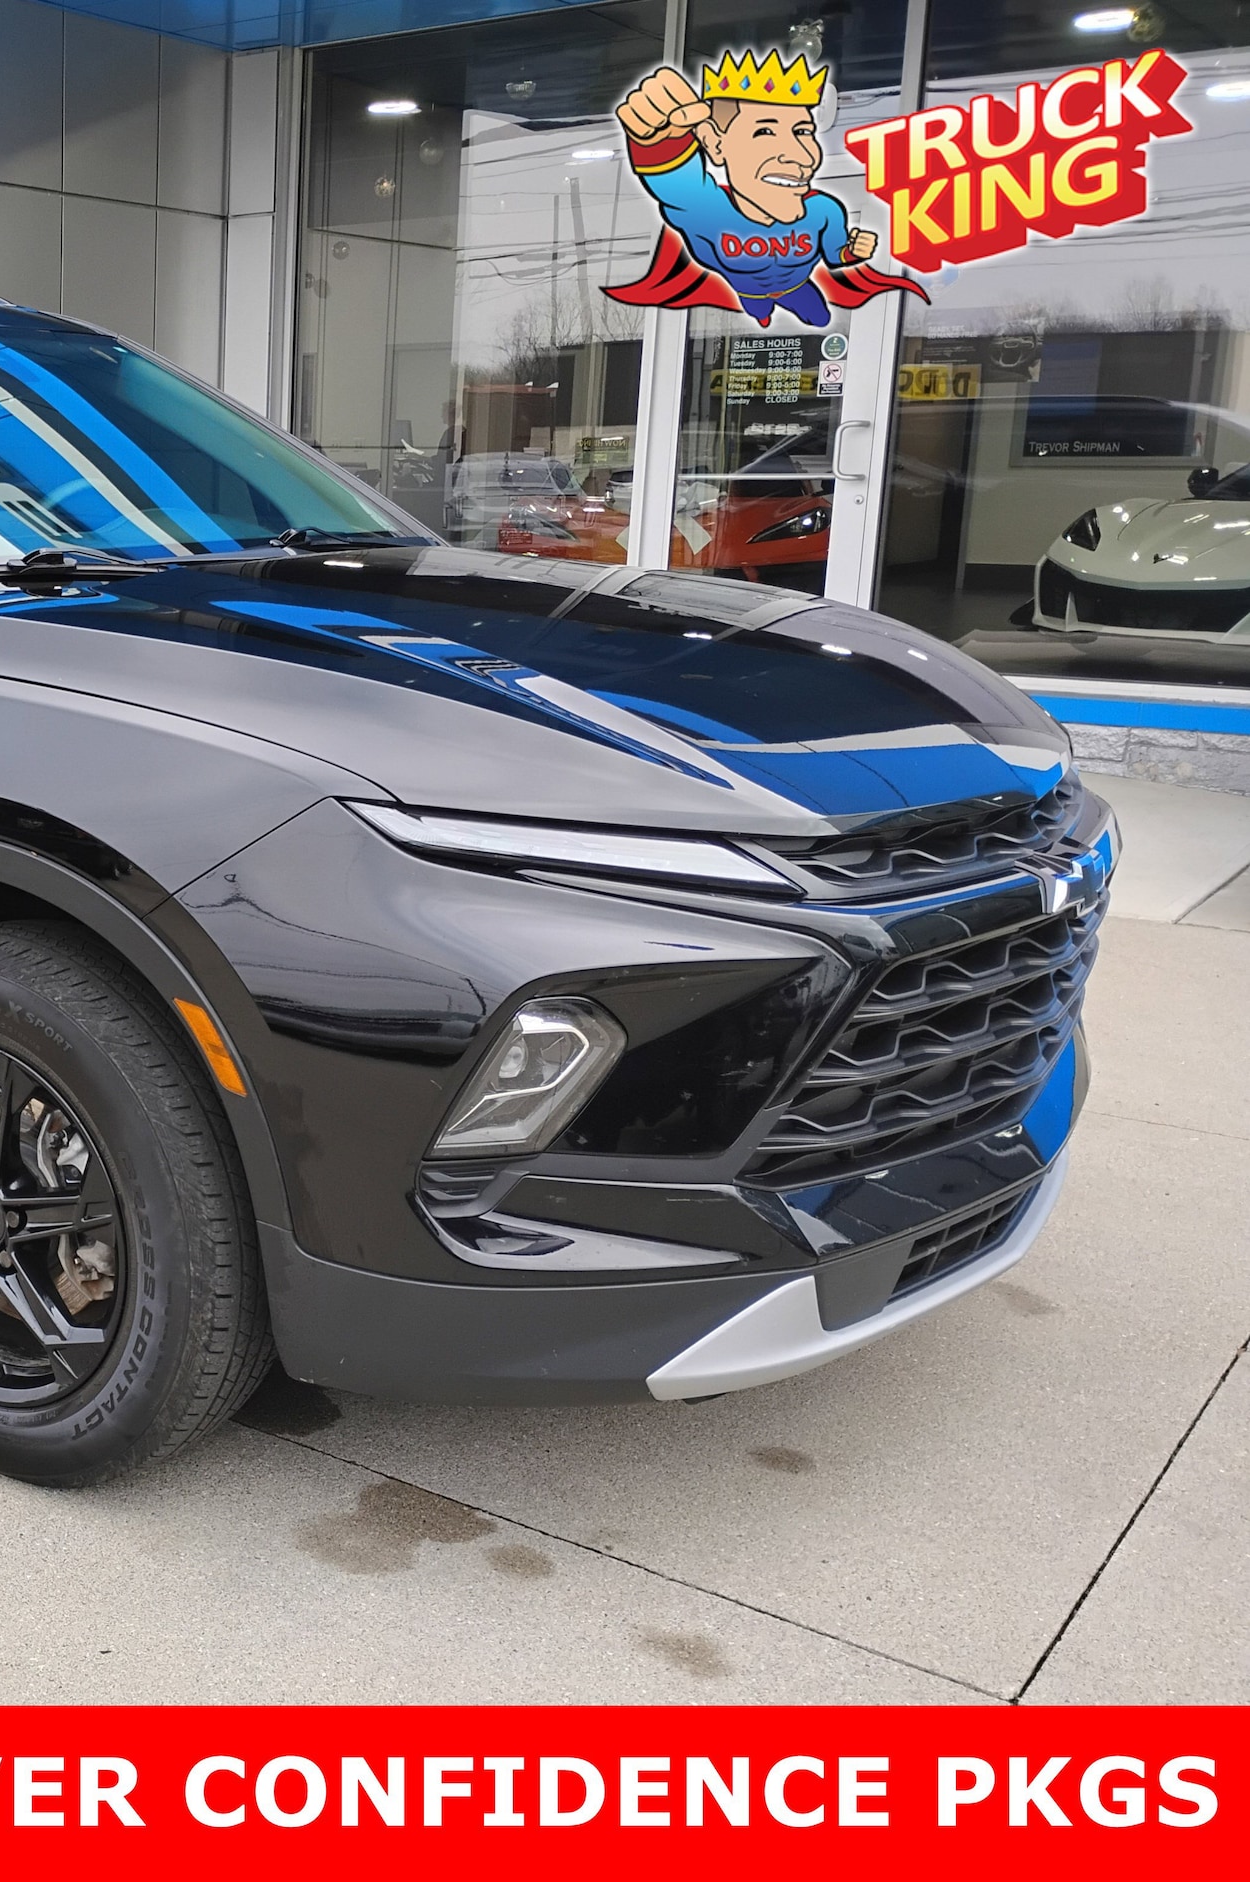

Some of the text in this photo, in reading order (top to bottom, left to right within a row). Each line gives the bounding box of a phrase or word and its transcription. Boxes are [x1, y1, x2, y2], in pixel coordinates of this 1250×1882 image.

[734, 338, 801, 349] SALES HOURS
[730, 350, 803, 360] Monday 9:00-7:00
[768, 358, 802, 366] 9:00-6:00
[729, 367, 766, 375] Wednesday
[728, 382, 748, 390] Friday
[765, 396, 798, 404] CLOSED
[1029, 440, 1120, 453] TREVOR SHIPMAN
[25, 1011, 73, 1053] SPORT
